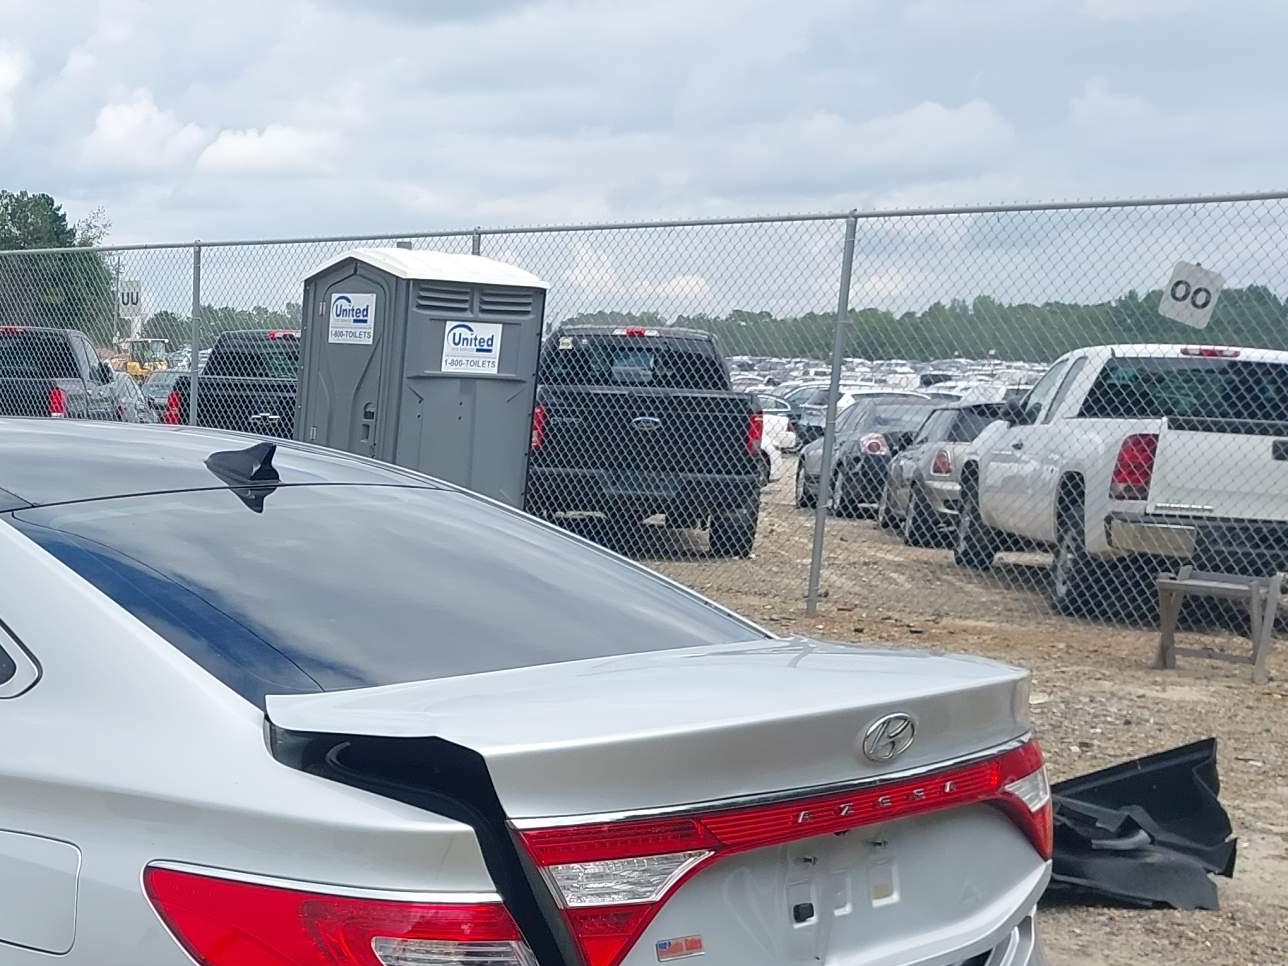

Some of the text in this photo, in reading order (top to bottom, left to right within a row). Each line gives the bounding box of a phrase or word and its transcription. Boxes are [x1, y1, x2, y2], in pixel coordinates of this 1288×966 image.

[335, 303, 370, 318] United
[330, 330, 371, 338] 1-800-TOILETS
[452, 332, 494, 347] United
[445, 359, 496, 368] 1-800-TOILETS
